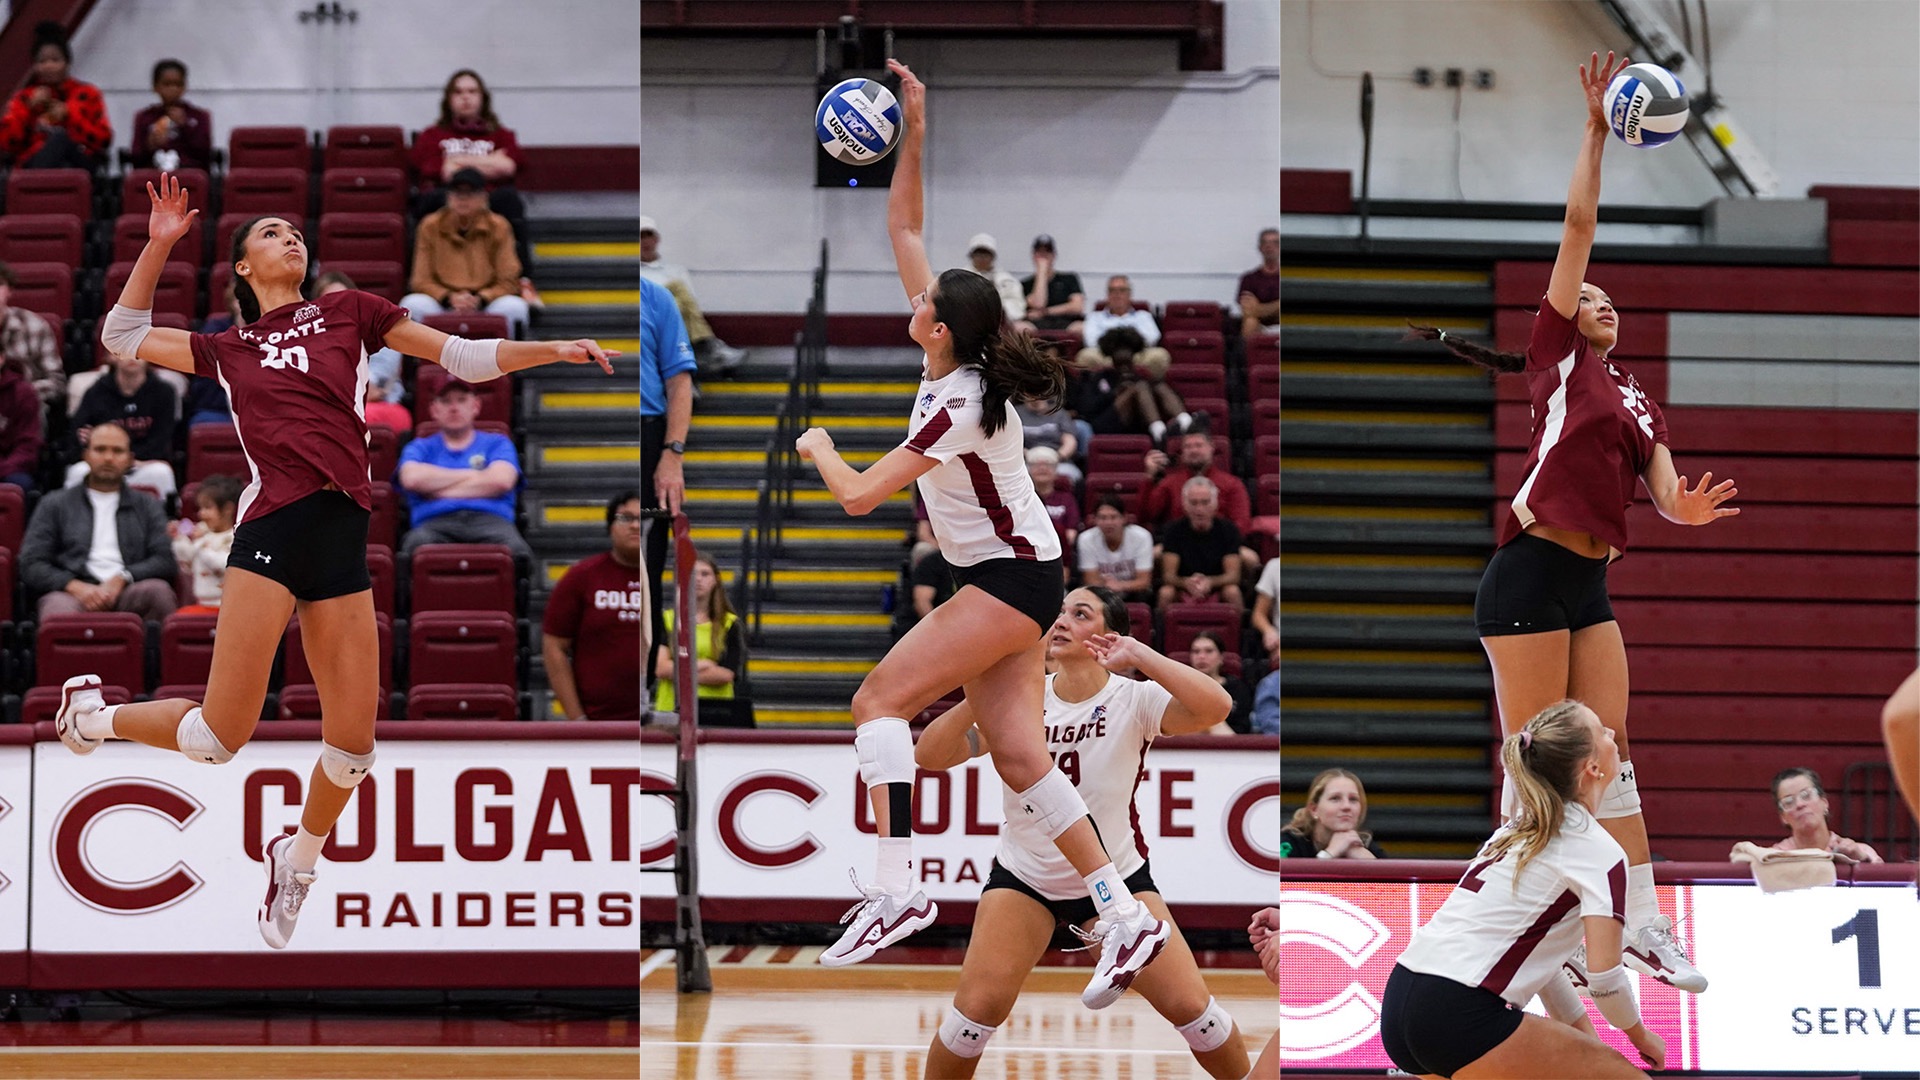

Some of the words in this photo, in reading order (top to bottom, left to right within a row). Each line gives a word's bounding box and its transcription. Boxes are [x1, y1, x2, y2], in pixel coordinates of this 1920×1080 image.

[842, 109, 877, 141] NCAA
[1613, 92, 1630, 133] NCAA
[1626, 95, 1645, 139] molten
[829, 117, 867, 155] molten
[259, 344, 309, 374] 20
[714, 769, 828, 870] C
[50, 776, 206, 915] C
[336, 892, 632, 927] RAIDERS
[1831, 908, 1881, 989] 1
